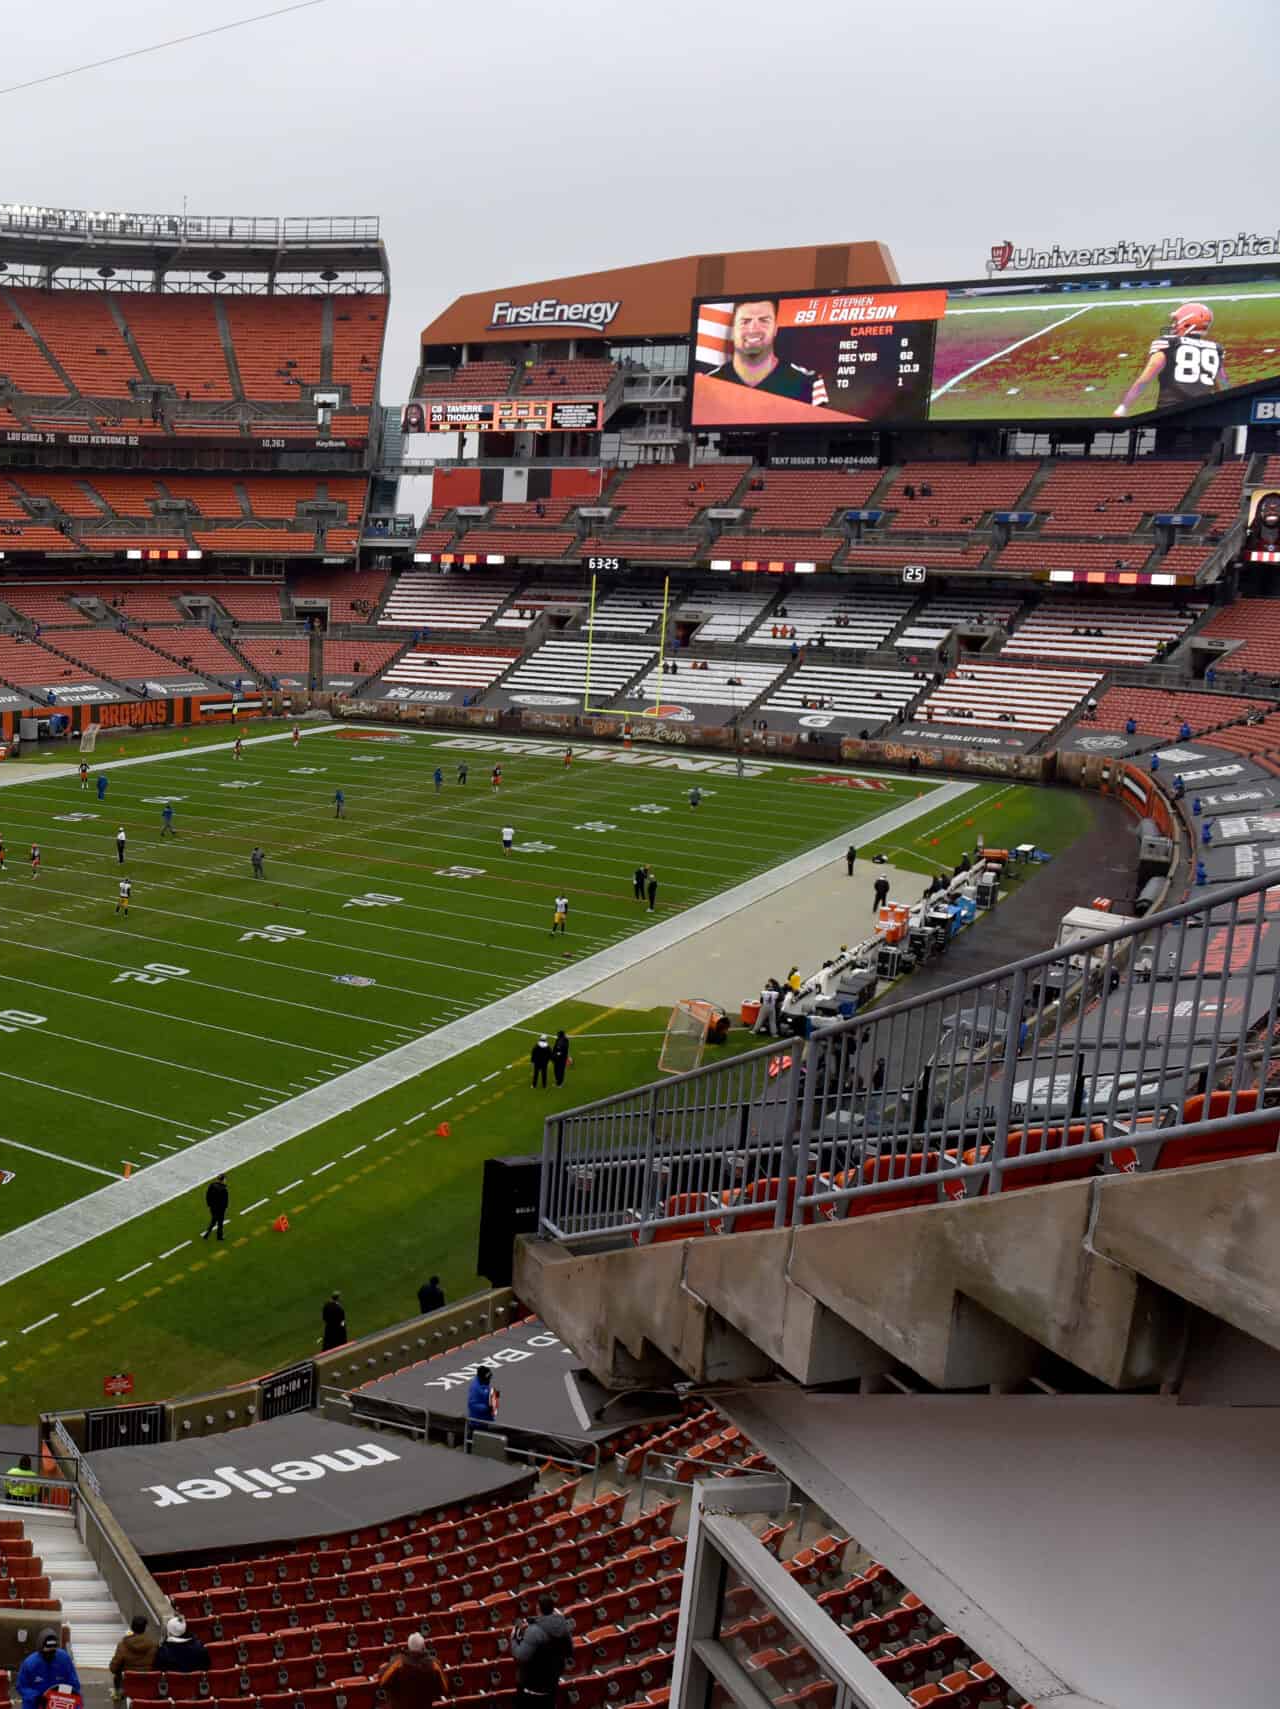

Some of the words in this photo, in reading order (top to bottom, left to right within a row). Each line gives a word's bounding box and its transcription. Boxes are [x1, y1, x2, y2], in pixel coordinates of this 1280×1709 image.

[1013, 241, 1153, 270] University
[831, 296, 874, 308] STEPHEN
[491, 299, 620, 325] FirstEnergy
[794, 310, 818, 323] 89
[829, 305, 898, 321] CARLSON
[850, 325, 893, 337] CAREER
[839, 340, 858, 350] REC
[838, 353, 857, 362] REC
[859, 352, 878, 362] YDS
[837, 366, 855, 376] AVG
[899, 363, 919, 374] 10.3
[1174, 346, 1220, 386] 89
[836, 379, 849, 389] TD
[431, 414, 443, 422] 20
[447, 413, 480, 422] THOMAS
[790, 456, 816, 465] ISSUES
[905, 567, 923, 580] 25
[99, 700, 168, 729] BROWNS
[430, 737, 774, 778] BROWNS
[345, 892, 405, 908] 40
[240, 924, 307, 943] 30
[114, 962, 191, 985] 20
[423, 1348, 535, 1391] BANK
[149, 1442, 402, 1508] meijer
